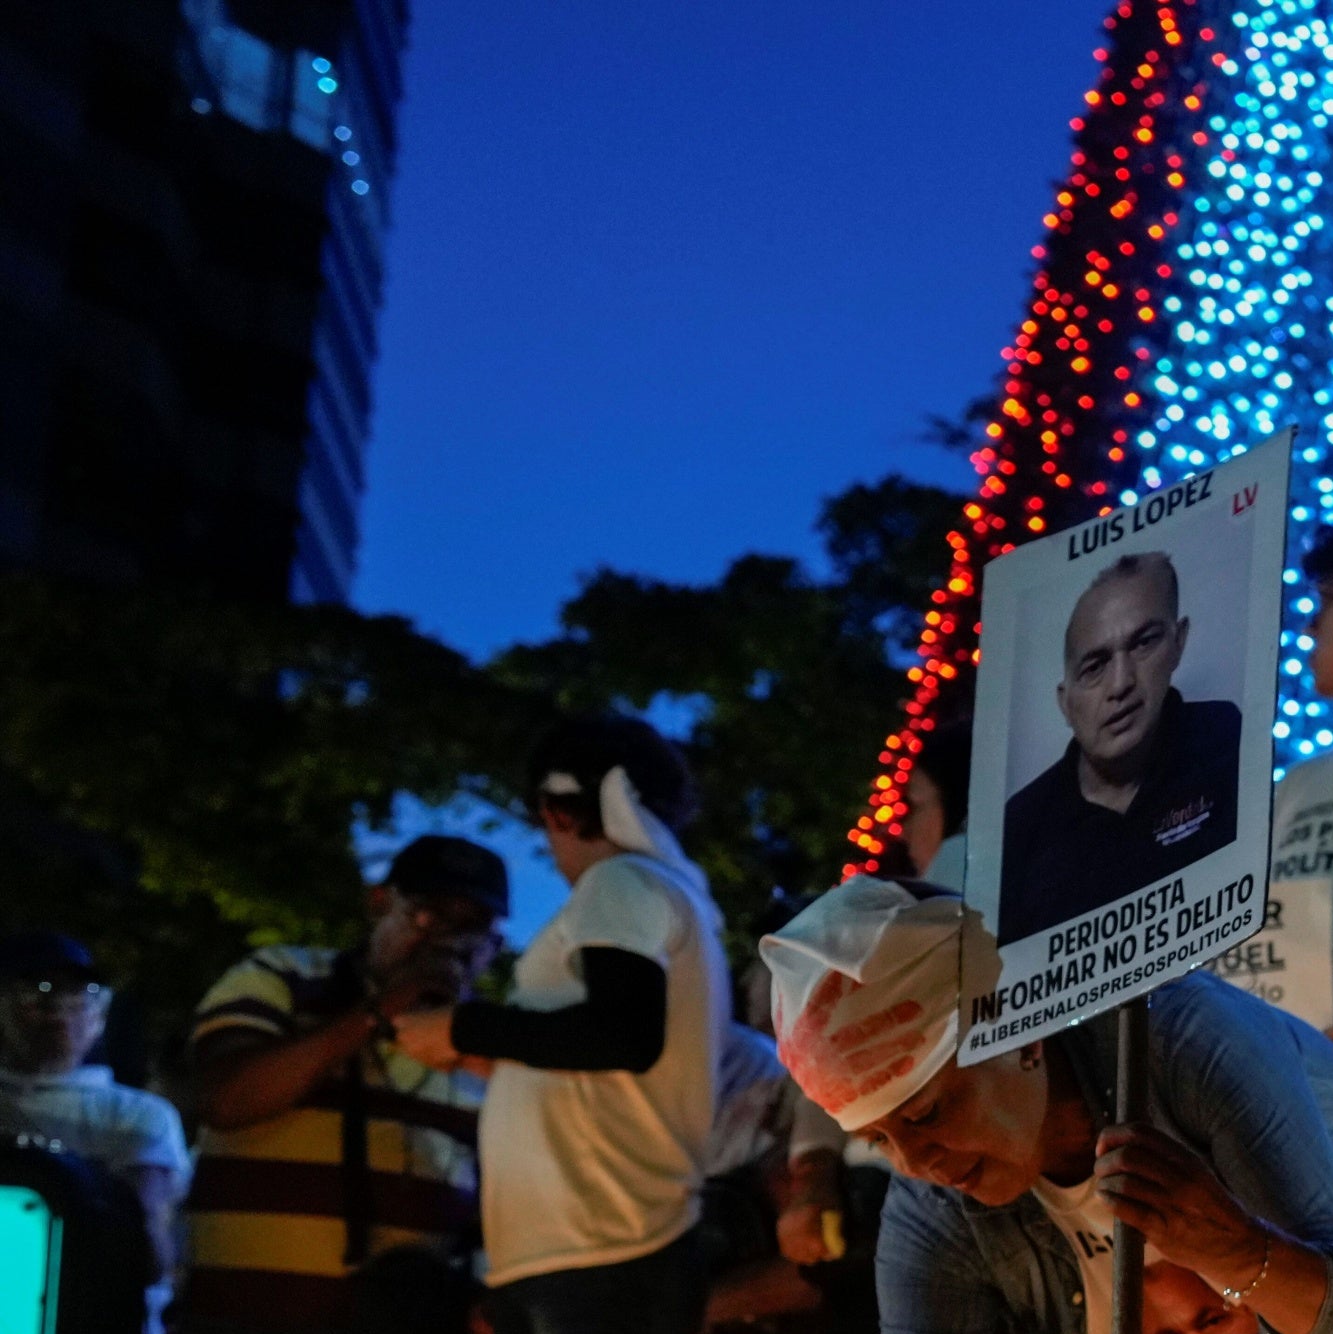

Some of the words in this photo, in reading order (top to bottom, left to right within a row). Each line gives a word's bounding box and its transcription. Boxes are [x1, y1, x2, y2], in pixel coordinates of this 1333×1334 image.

[1067, 513, 1124, 561] LUIS
[1232, 483, 1258, 516] LV
[972, 952, 1096, 1025] INFORMAR
[1103, 938, 1137, 973] NO
[1145, 917, 1169, 955] ES
[1176, 873, 1254, 939] DELITO
[1048, 878, 1185, 963] PERIODISTA
[970, 909, 1253, 1051] #LIBERENALOSPRESOSPOLITICOS
